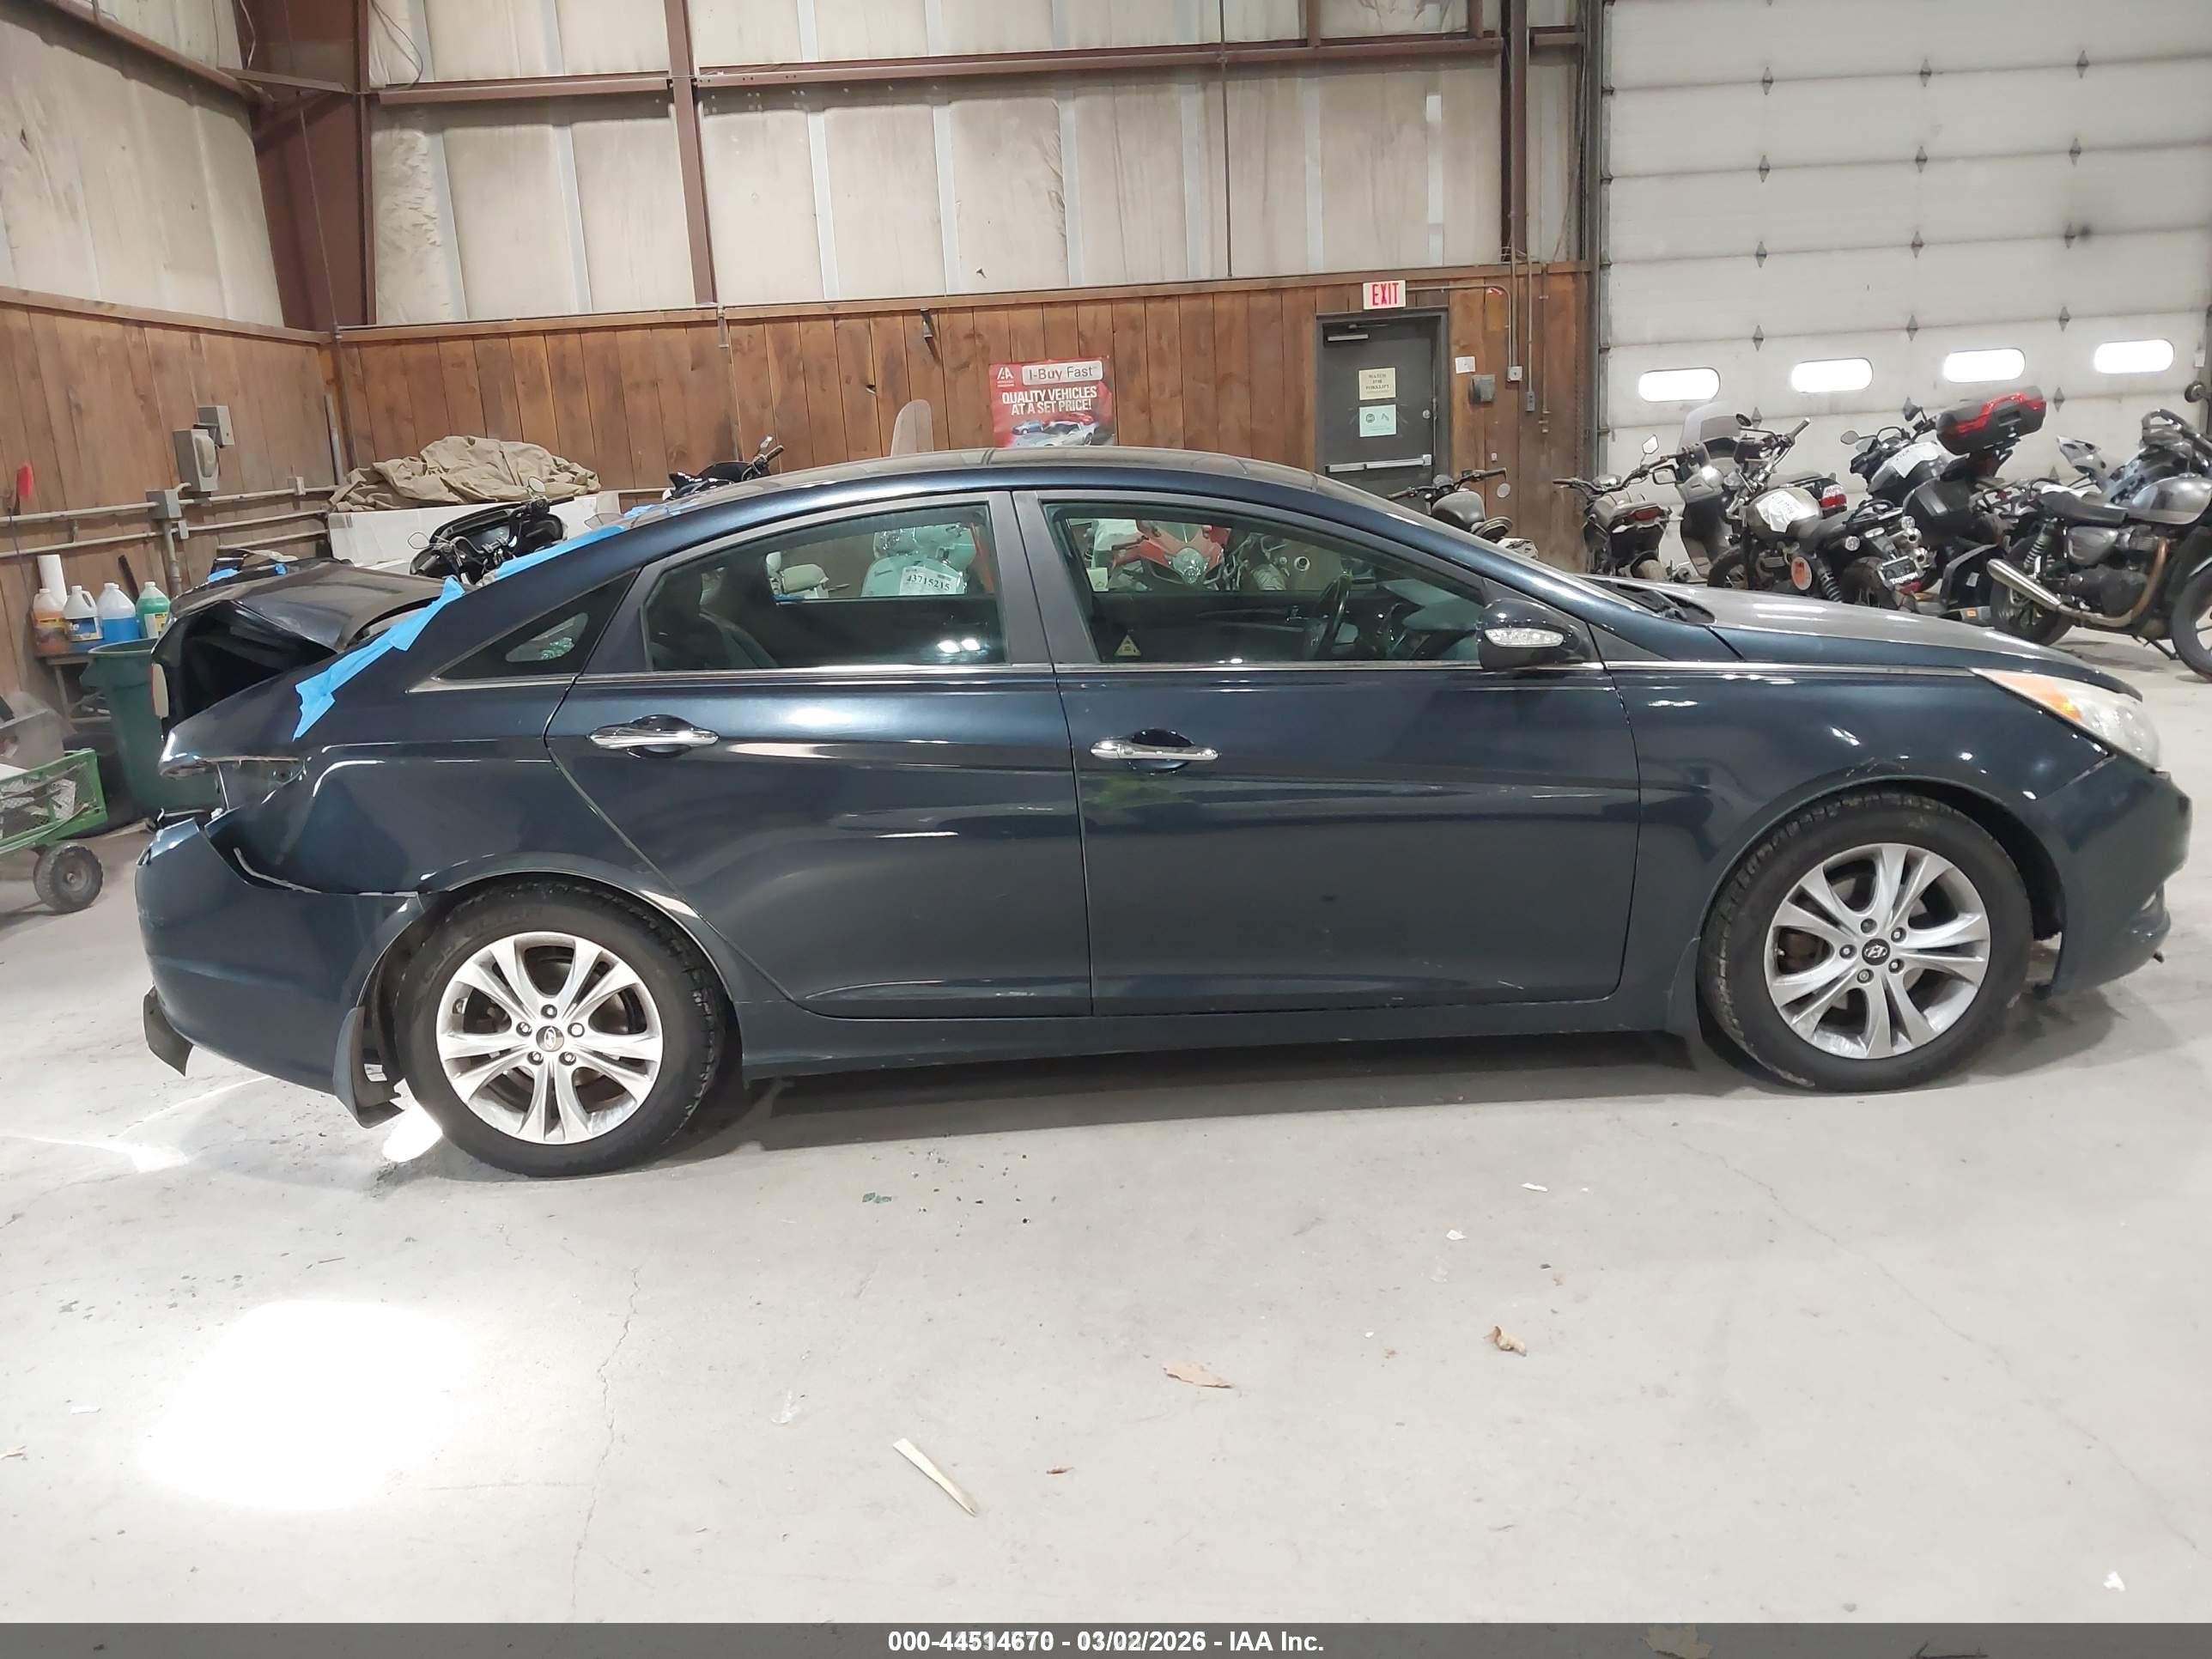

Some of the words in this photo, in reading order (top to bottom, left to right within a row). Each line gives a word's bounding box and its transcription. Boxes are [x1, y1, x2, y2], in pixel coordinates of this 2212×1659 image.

[1372, 283, 1399, 306] EXIT
[1029, 368, 1062, 380] I-Buy
[1002, 389, 1046, 404] QUALITY
[1048, 386, 1097, 401] VEHICLES
[1011, 403, 1026, 416] AT
[1027, 403, 1036, 414] A
[1036, 400, 1057, 414] SET
[1059, 398, 1091, 412] PRICE!
[907, 574, 950, 591] 43715215
